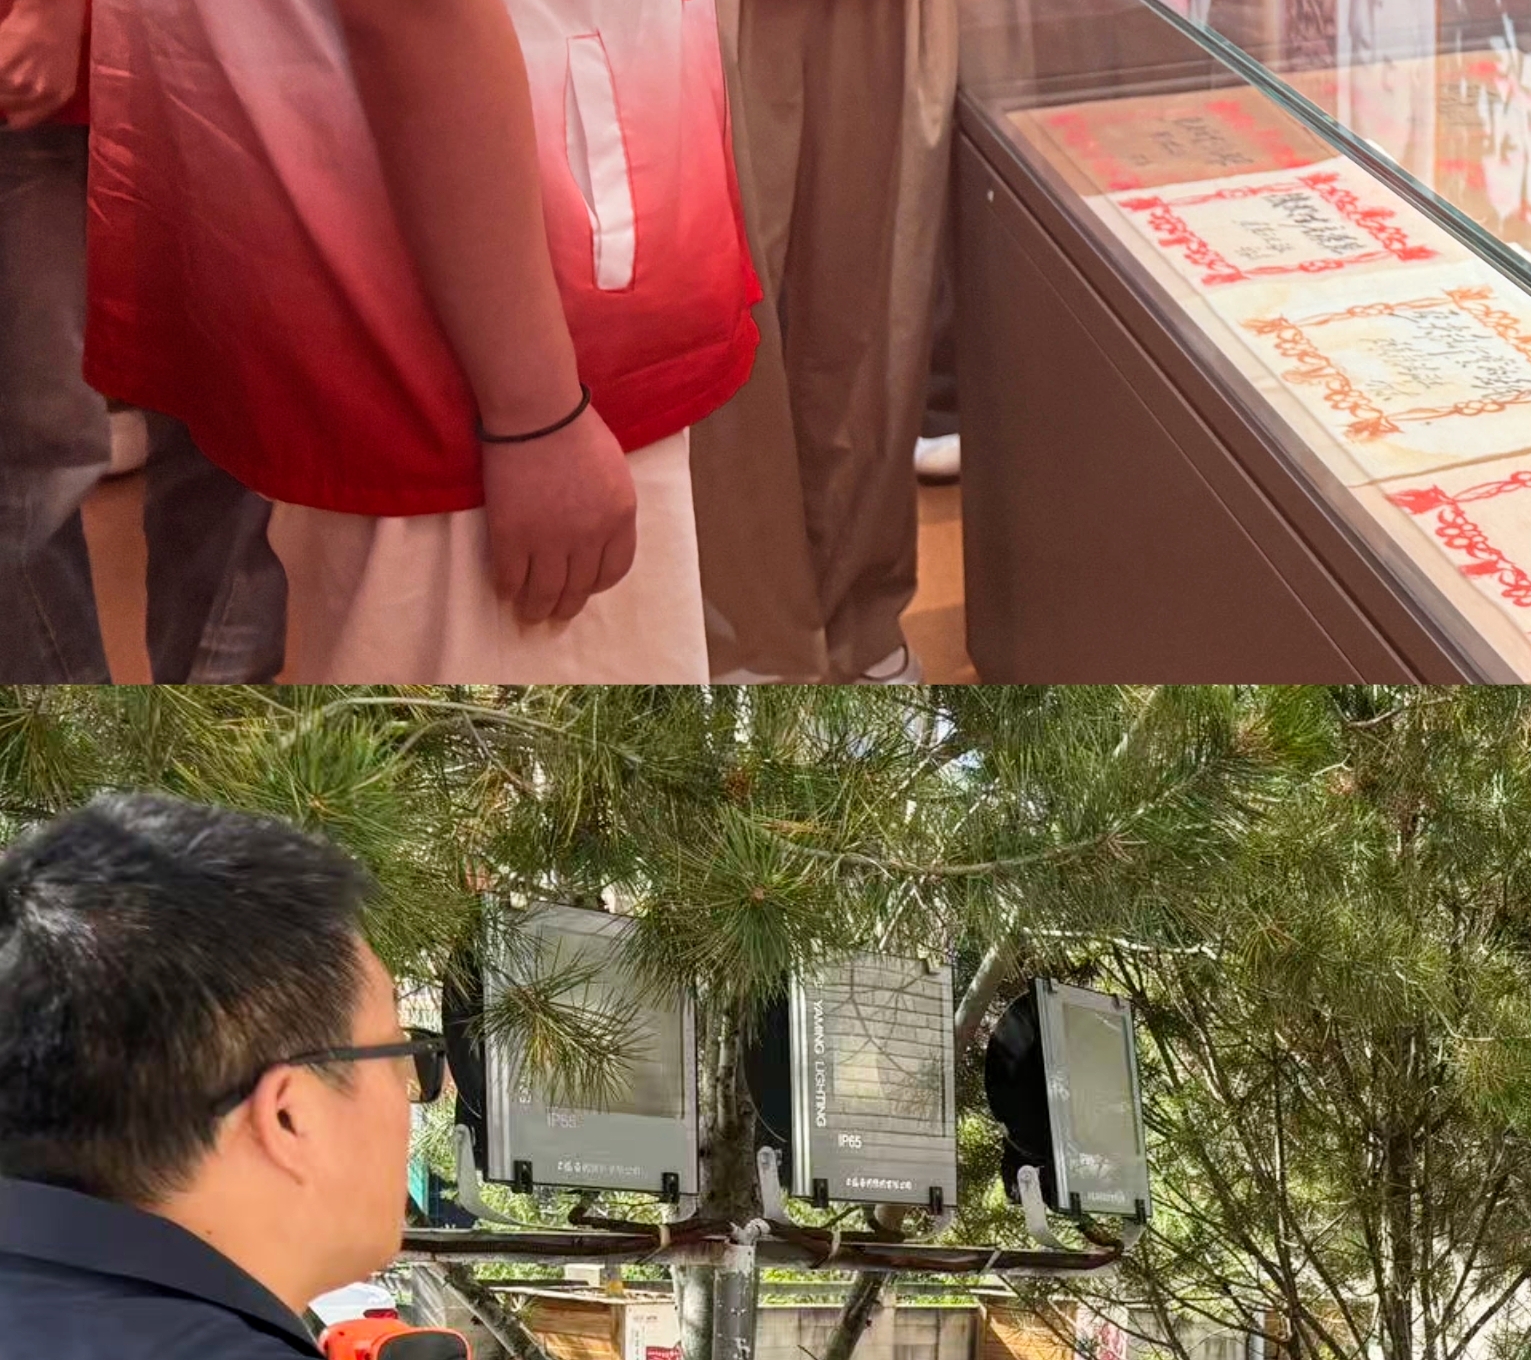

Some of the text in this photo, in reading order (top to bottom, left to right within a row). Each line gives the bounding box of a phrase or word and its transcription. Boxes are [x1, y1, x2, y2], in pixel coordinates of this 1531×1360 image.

[813, 999, 827, 1128] YAMING LIGHTING
[838, 1134, 863, 1150] IP65
